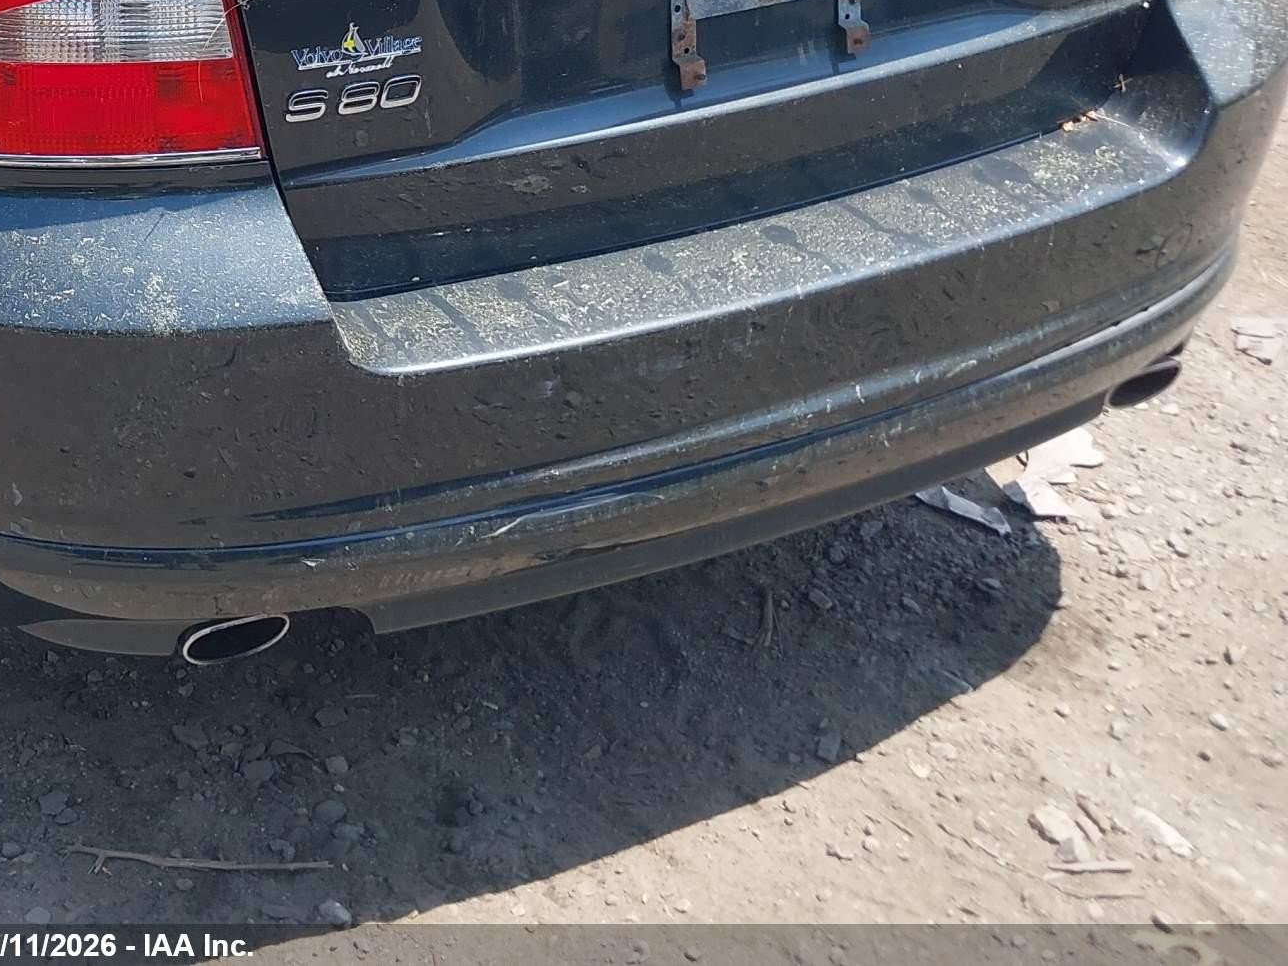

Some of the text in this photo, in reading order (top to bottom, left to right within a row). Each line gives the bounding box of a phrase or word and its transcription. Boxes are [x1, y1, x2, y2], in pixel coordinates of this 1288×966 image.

[291, 35, 423, 67] Volvo Village
[285, 74, 422, 123] S80
